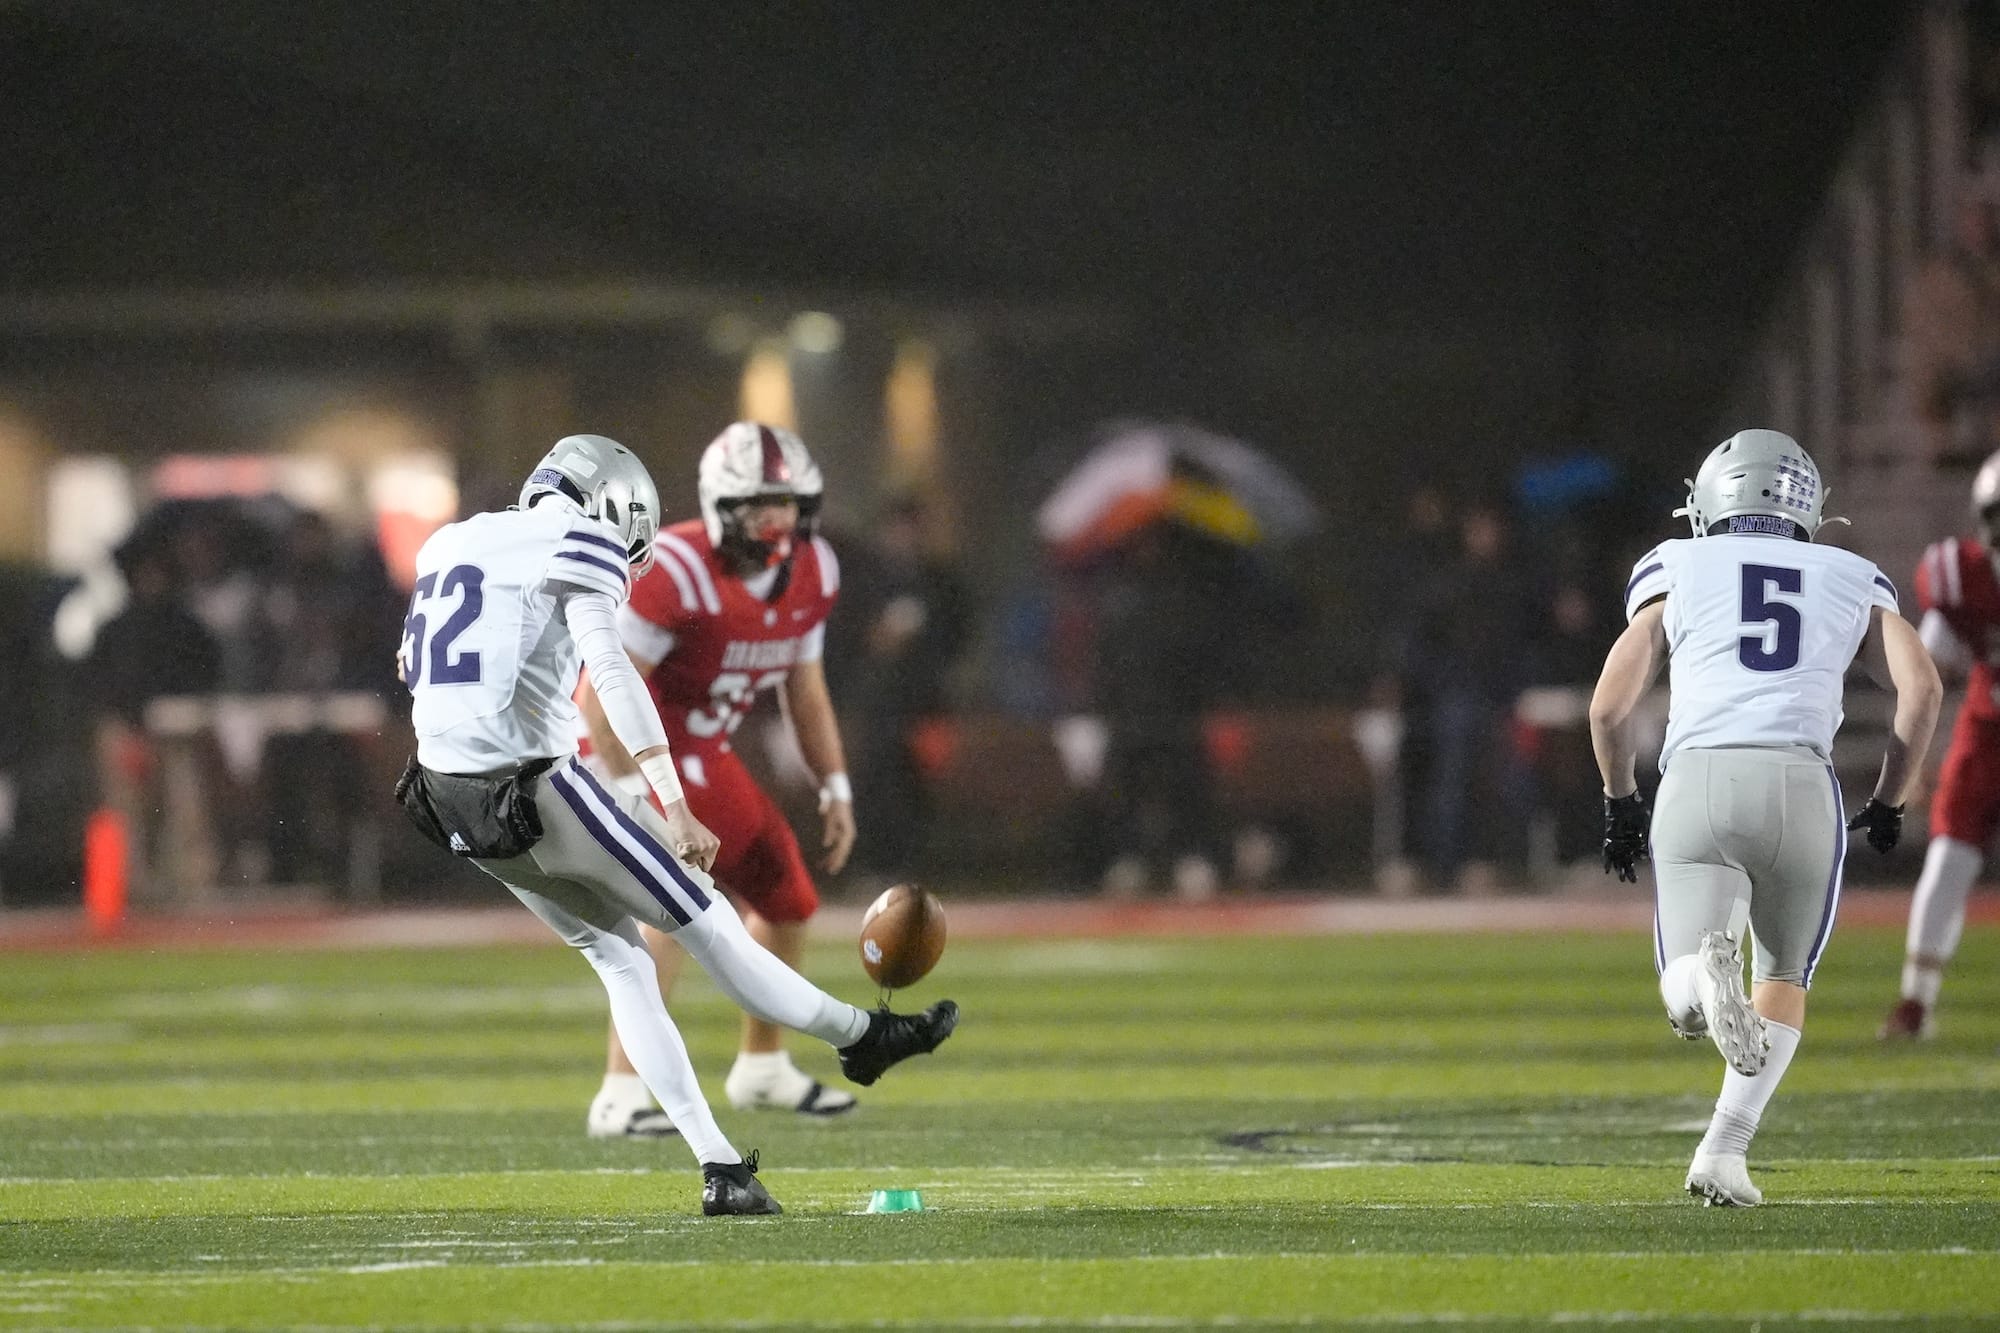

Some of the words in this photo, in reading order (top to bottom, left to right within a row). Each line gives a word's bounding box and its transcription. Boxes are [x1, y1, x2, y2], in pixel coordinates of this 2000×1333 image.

[1728, 516, 1796, 537] PANTHERS
[403, 564, 485, 691] 52
[1738, 562, 1805, 672] 5
